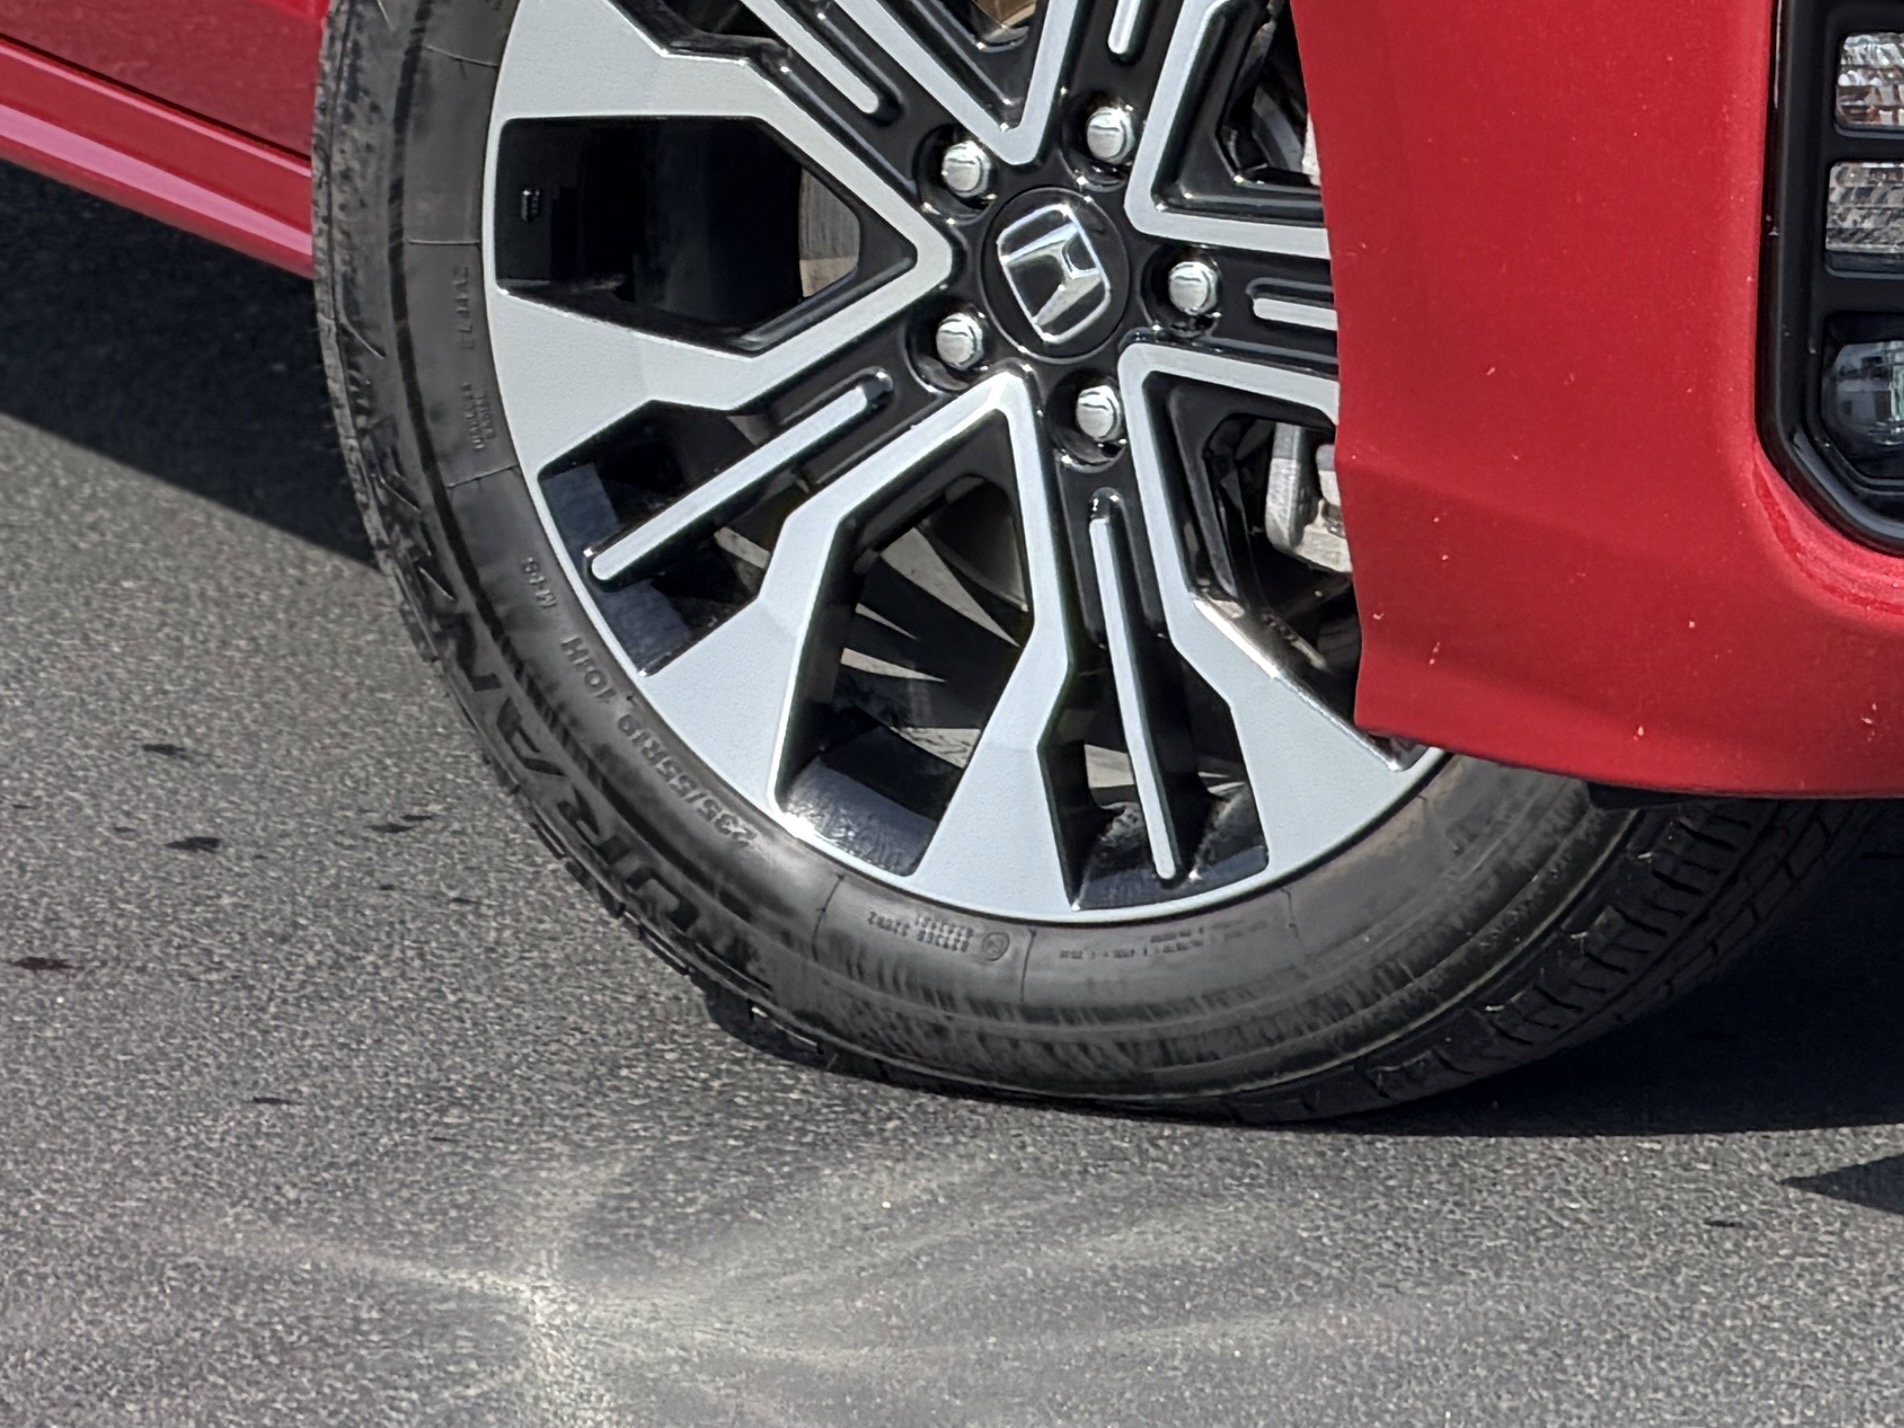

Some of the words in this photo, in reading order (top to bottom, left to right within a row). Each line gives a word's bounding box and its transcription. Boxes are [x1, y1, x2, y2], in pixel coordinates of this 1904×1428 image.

[368, 422, 782, 992] TURANZA
[558, 631, 619, 709] 101H
[613, 709, 757, 854] 235/55R19
